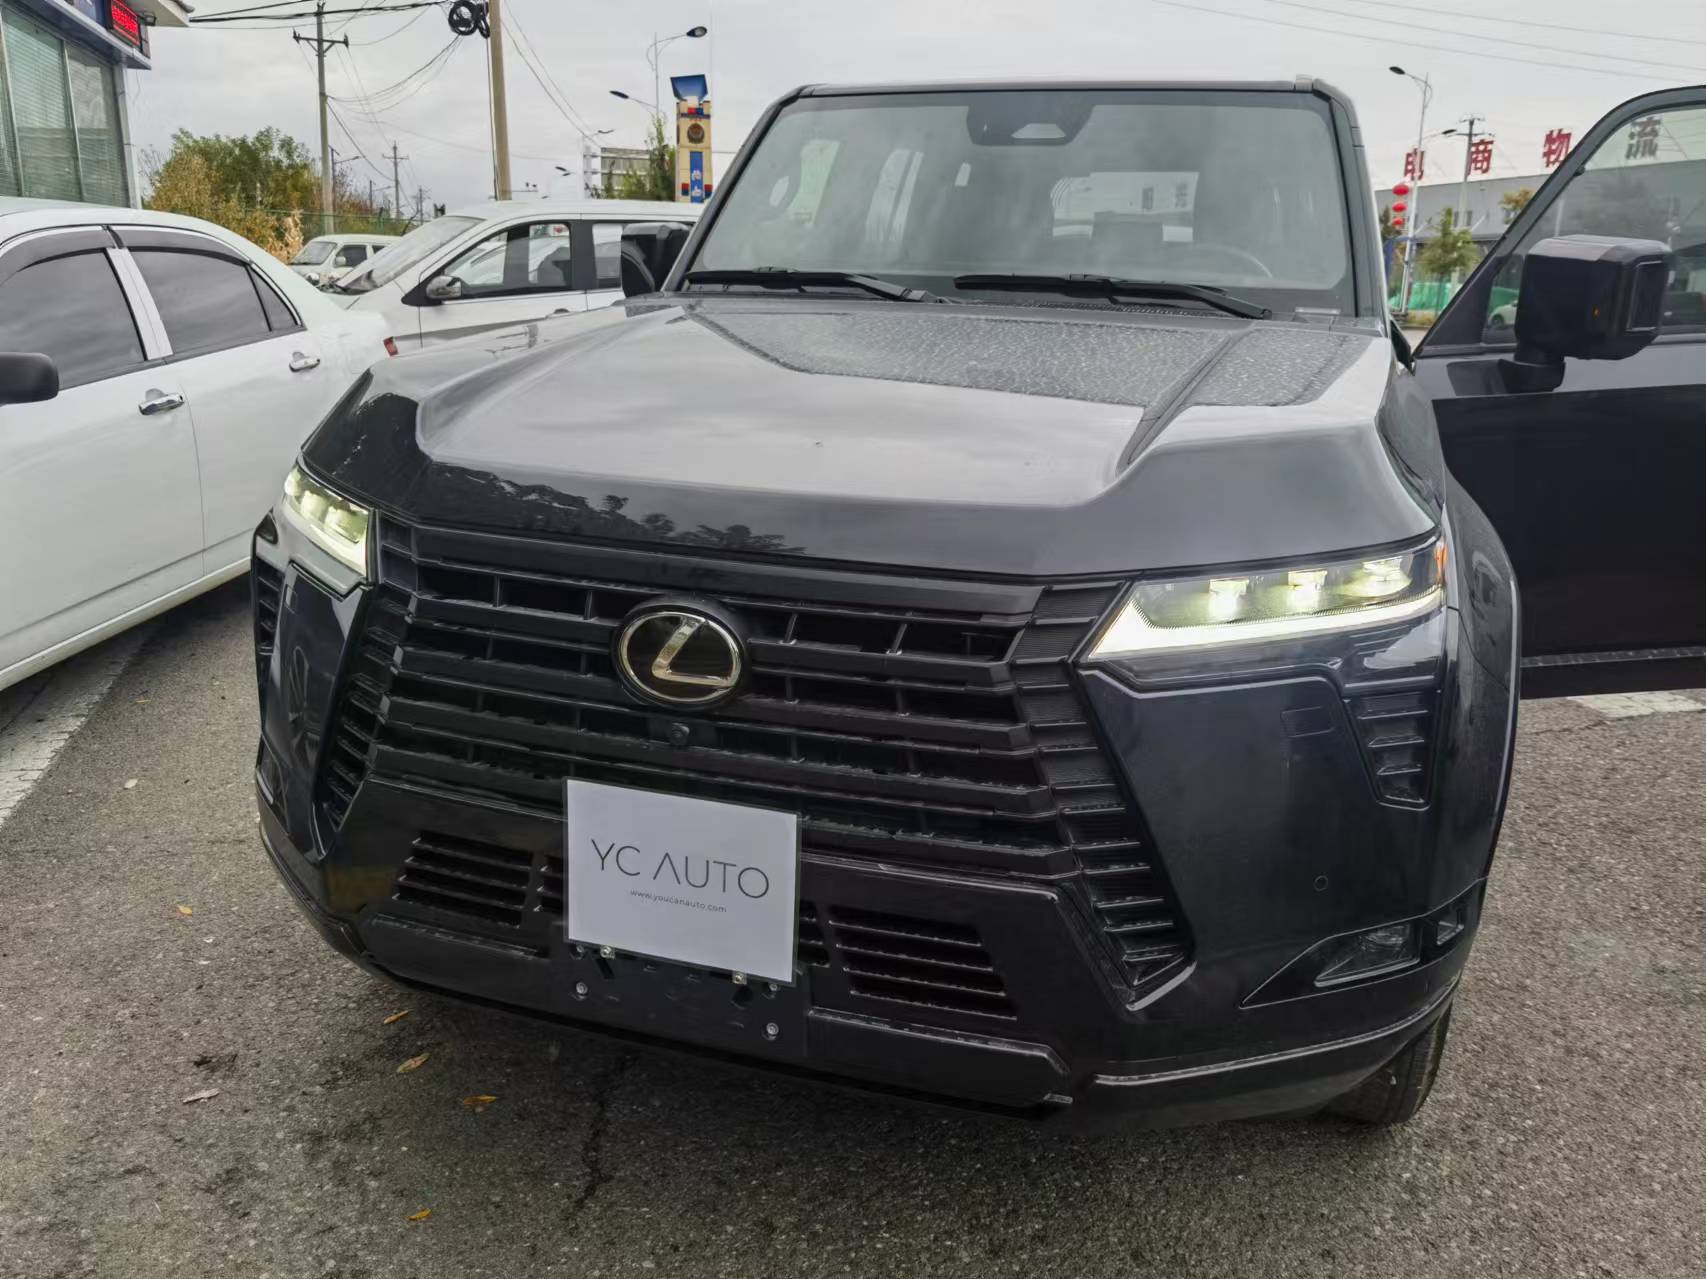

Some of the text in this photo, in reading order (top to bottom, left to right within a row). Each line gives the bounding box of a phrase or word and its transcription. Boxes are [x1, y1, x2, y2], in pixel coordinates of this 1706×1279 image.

[1403, 117, 1662, 182] 电商物流
[591, 839, 769, 899] YC AUTO
[630, 889, 727, 913] www.youcanauto.com
